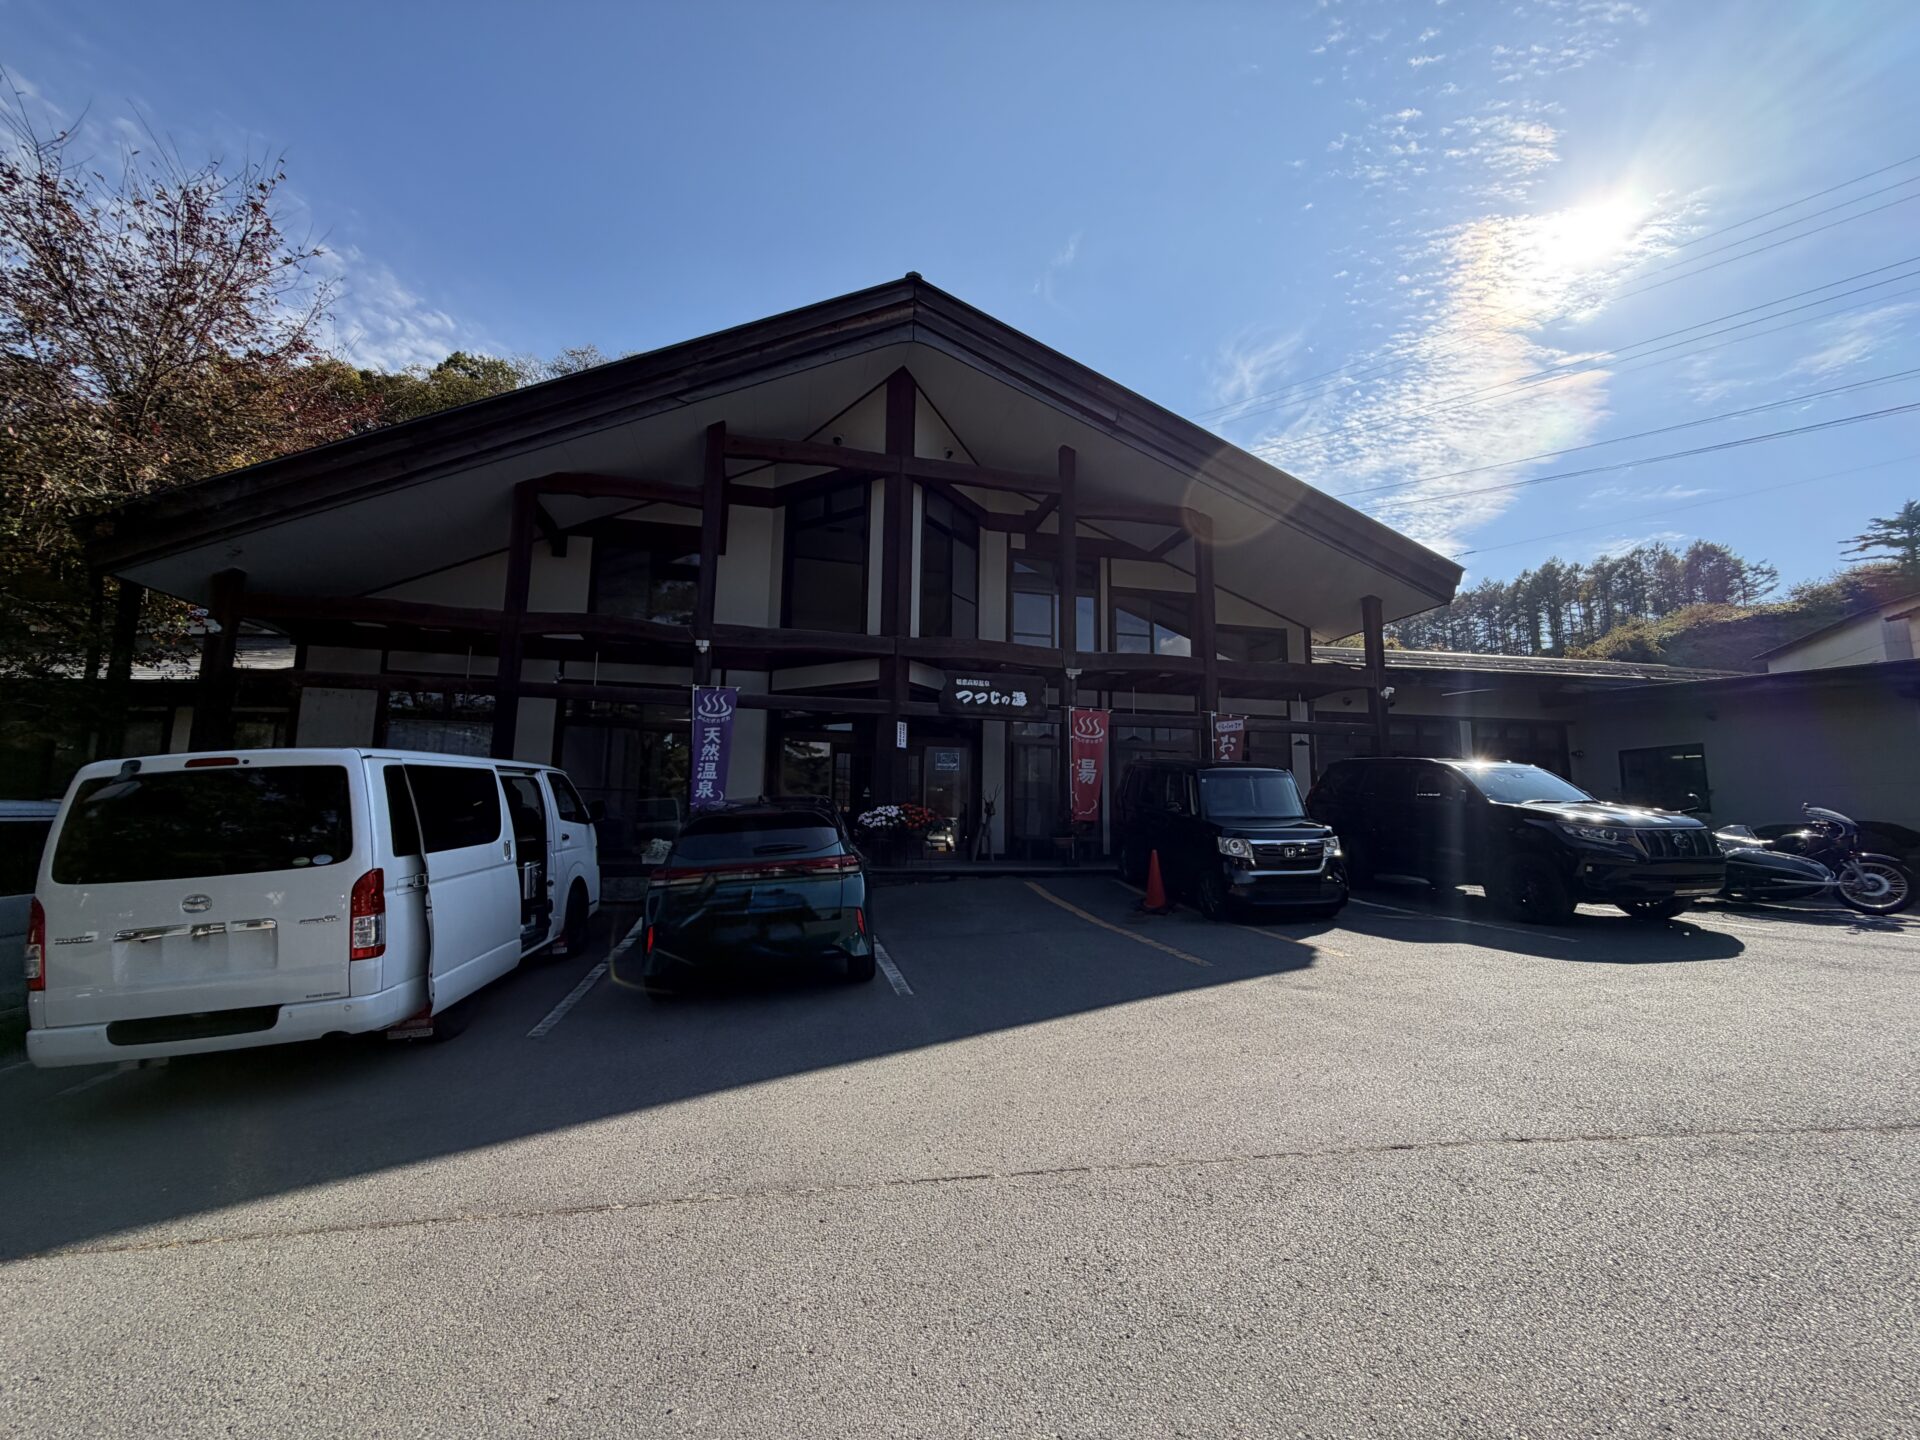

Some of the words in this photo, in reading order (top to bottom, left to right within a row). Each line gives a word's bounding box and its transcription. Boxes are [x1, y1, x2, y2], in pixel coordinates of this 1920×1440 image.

[955, 690, 1028, 707] つつじの湯
[1219, 734, 1237, 760] お
[695, 727, 721, 799] 天然温泉
[1077, 758, 1097, 785] 湯
